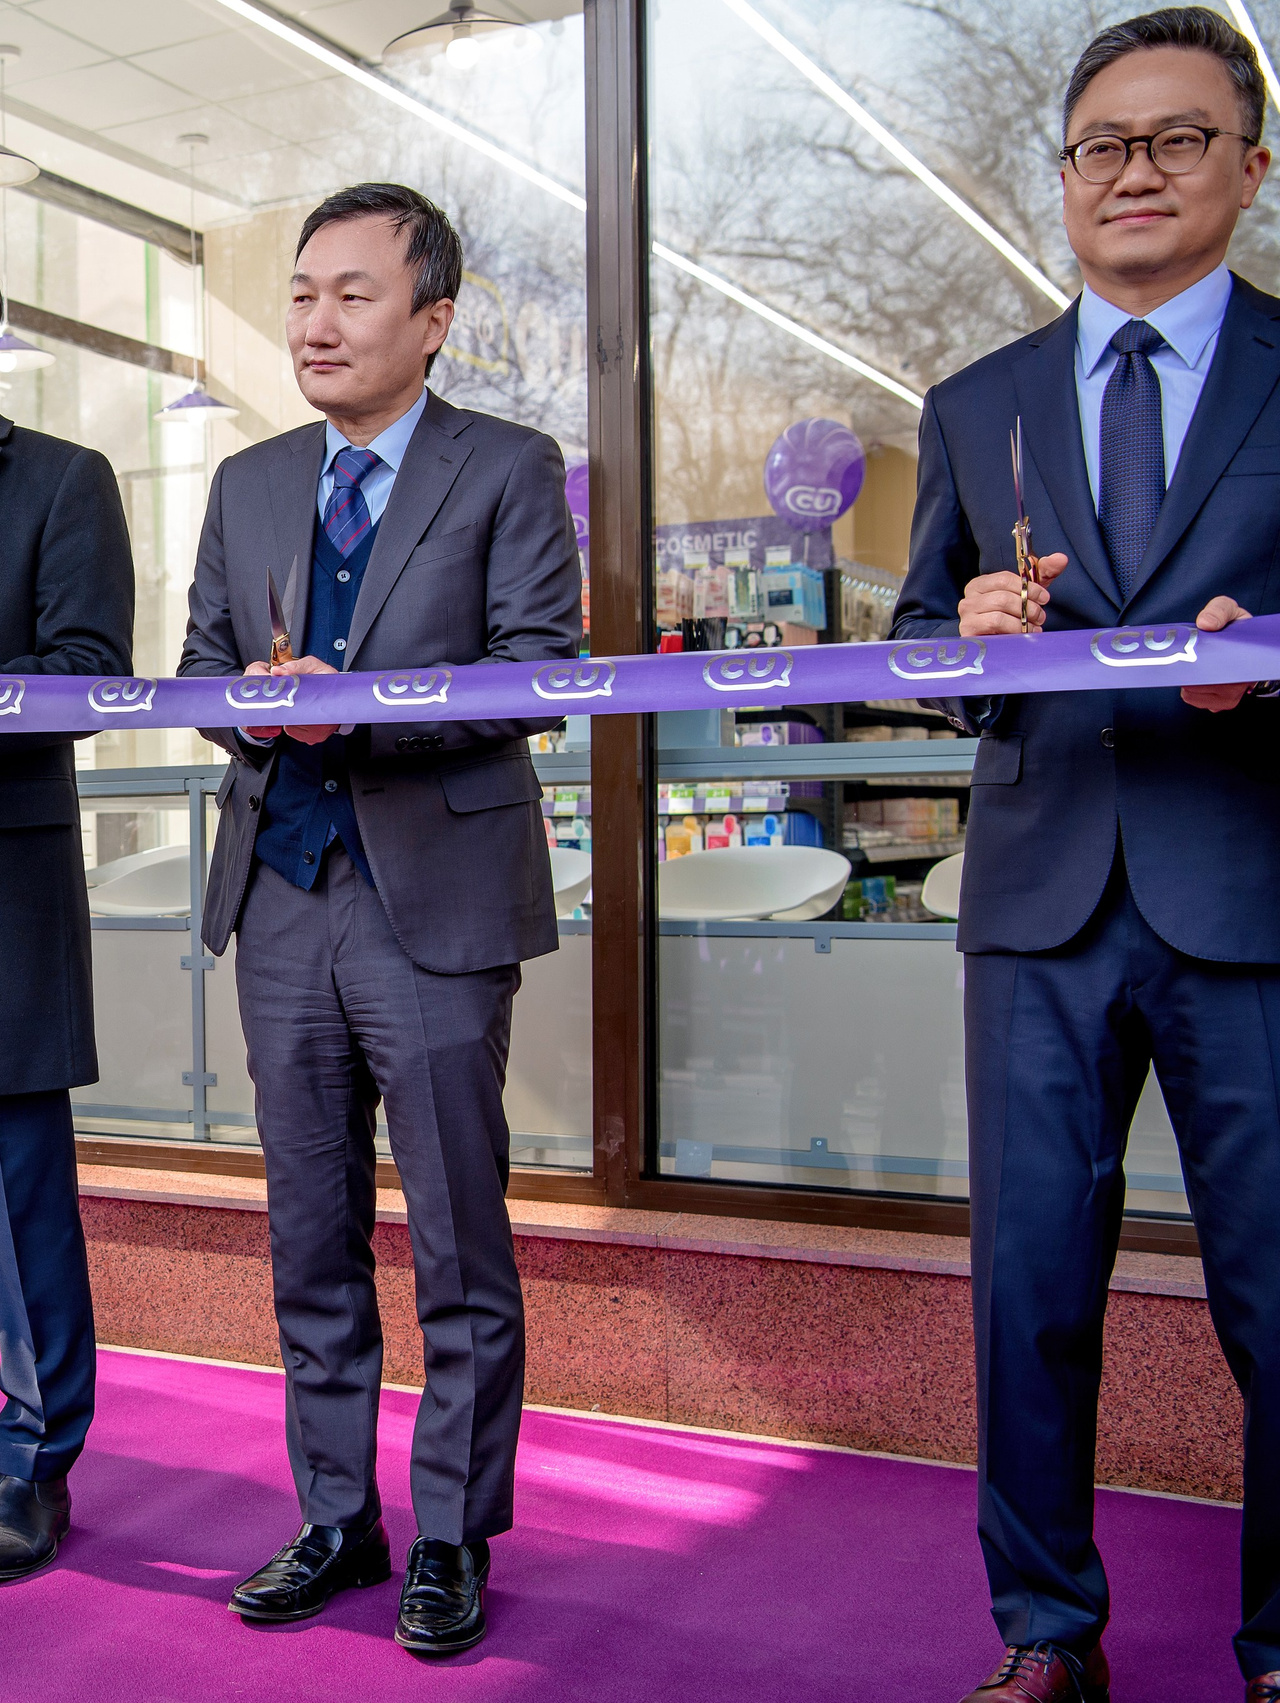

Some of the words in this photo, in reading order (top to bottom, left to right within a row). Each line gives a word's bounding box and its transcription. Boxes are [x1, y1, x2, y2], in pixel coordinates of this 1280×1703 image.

[796, 493, 832, 511] CU
[656, 530, 757, 555] COSMETIC
[1110, 629, 1177, 653] CU
[906, 644, 967, 668] CU
[548, 667, 600, 688] CU
[720, 656, 777, 680] CU
[100, 681, 145, 702] CU
[239, 678, 287, 698] CU
[387, 674, 438, 693] CU
